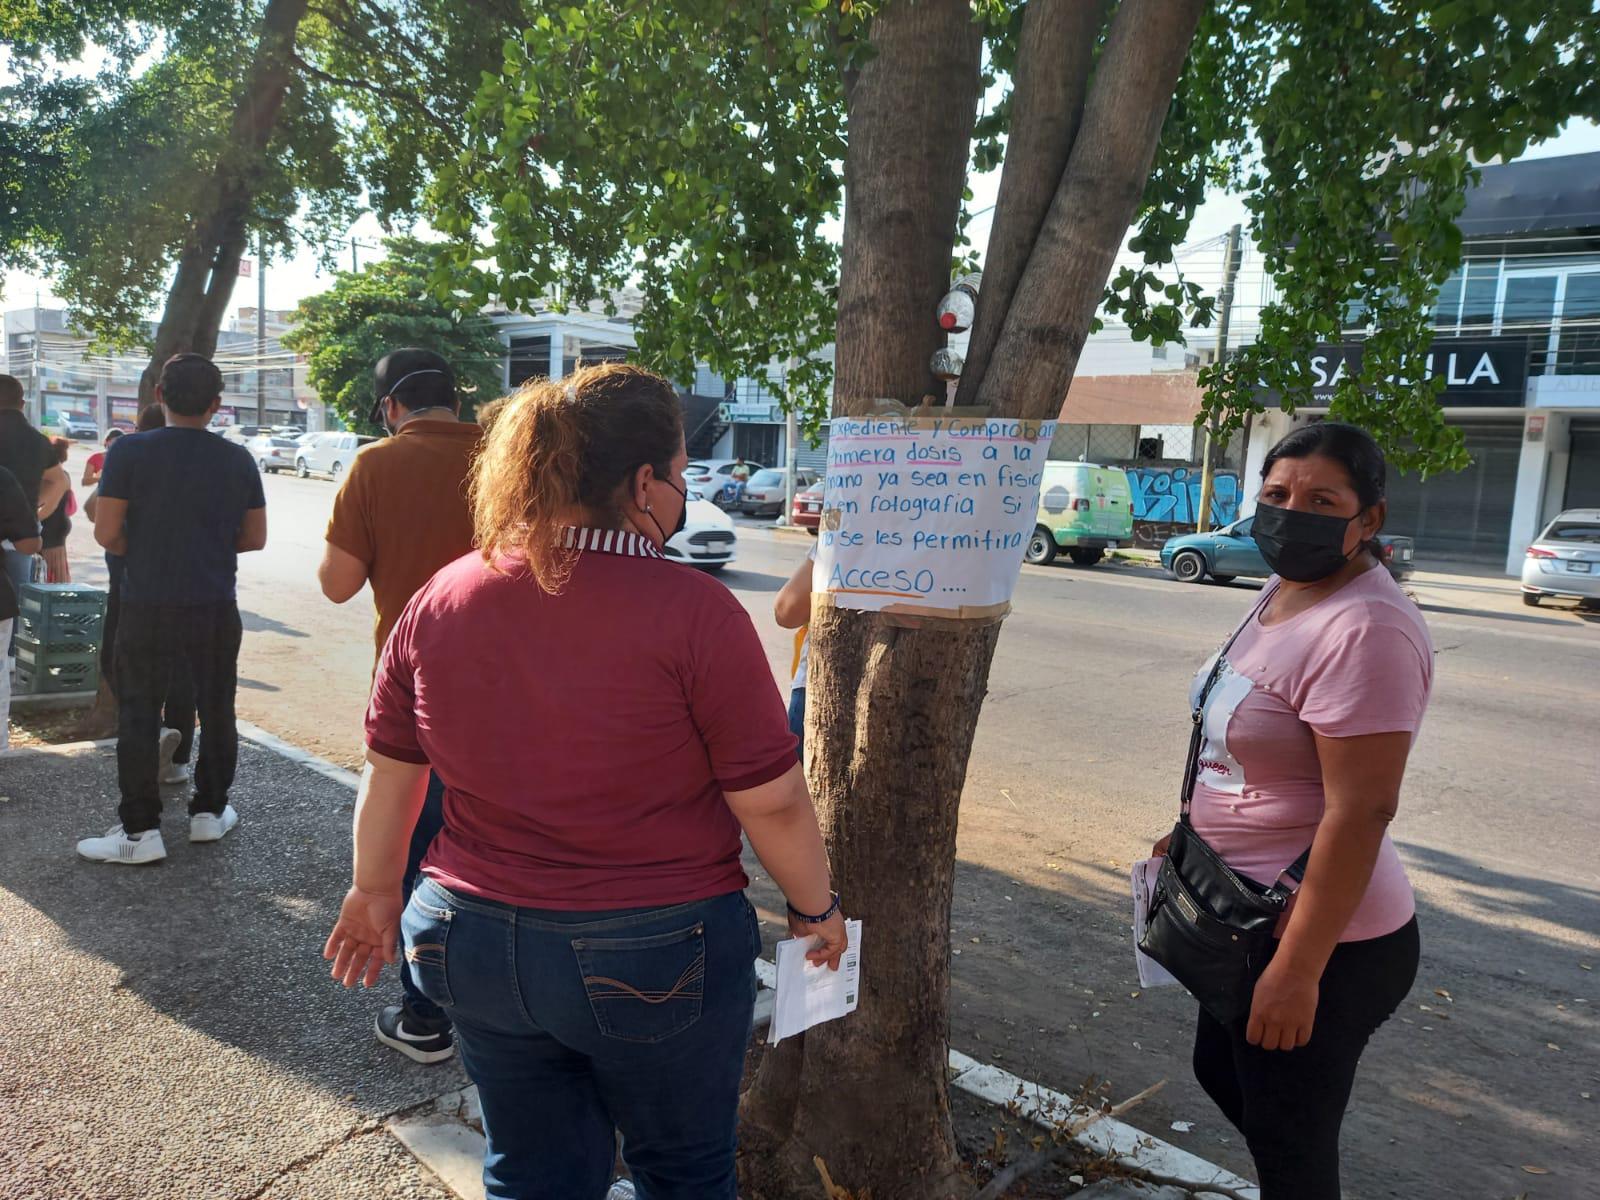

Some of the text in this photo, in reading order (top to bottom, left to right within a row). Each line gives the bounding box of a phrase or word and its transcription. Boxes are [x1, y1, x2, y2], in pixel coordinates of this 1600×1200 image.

[1256, 351, 1500, 388] SA LLA
[906, 441, 962, 462] dosis
[982, 445, 998, 460] a
[1014, 445, 1031, 461] la
[878, 472, 899, 490] ya
[958, 473, 986, 487] en
[876, 530, 903, 546] les
